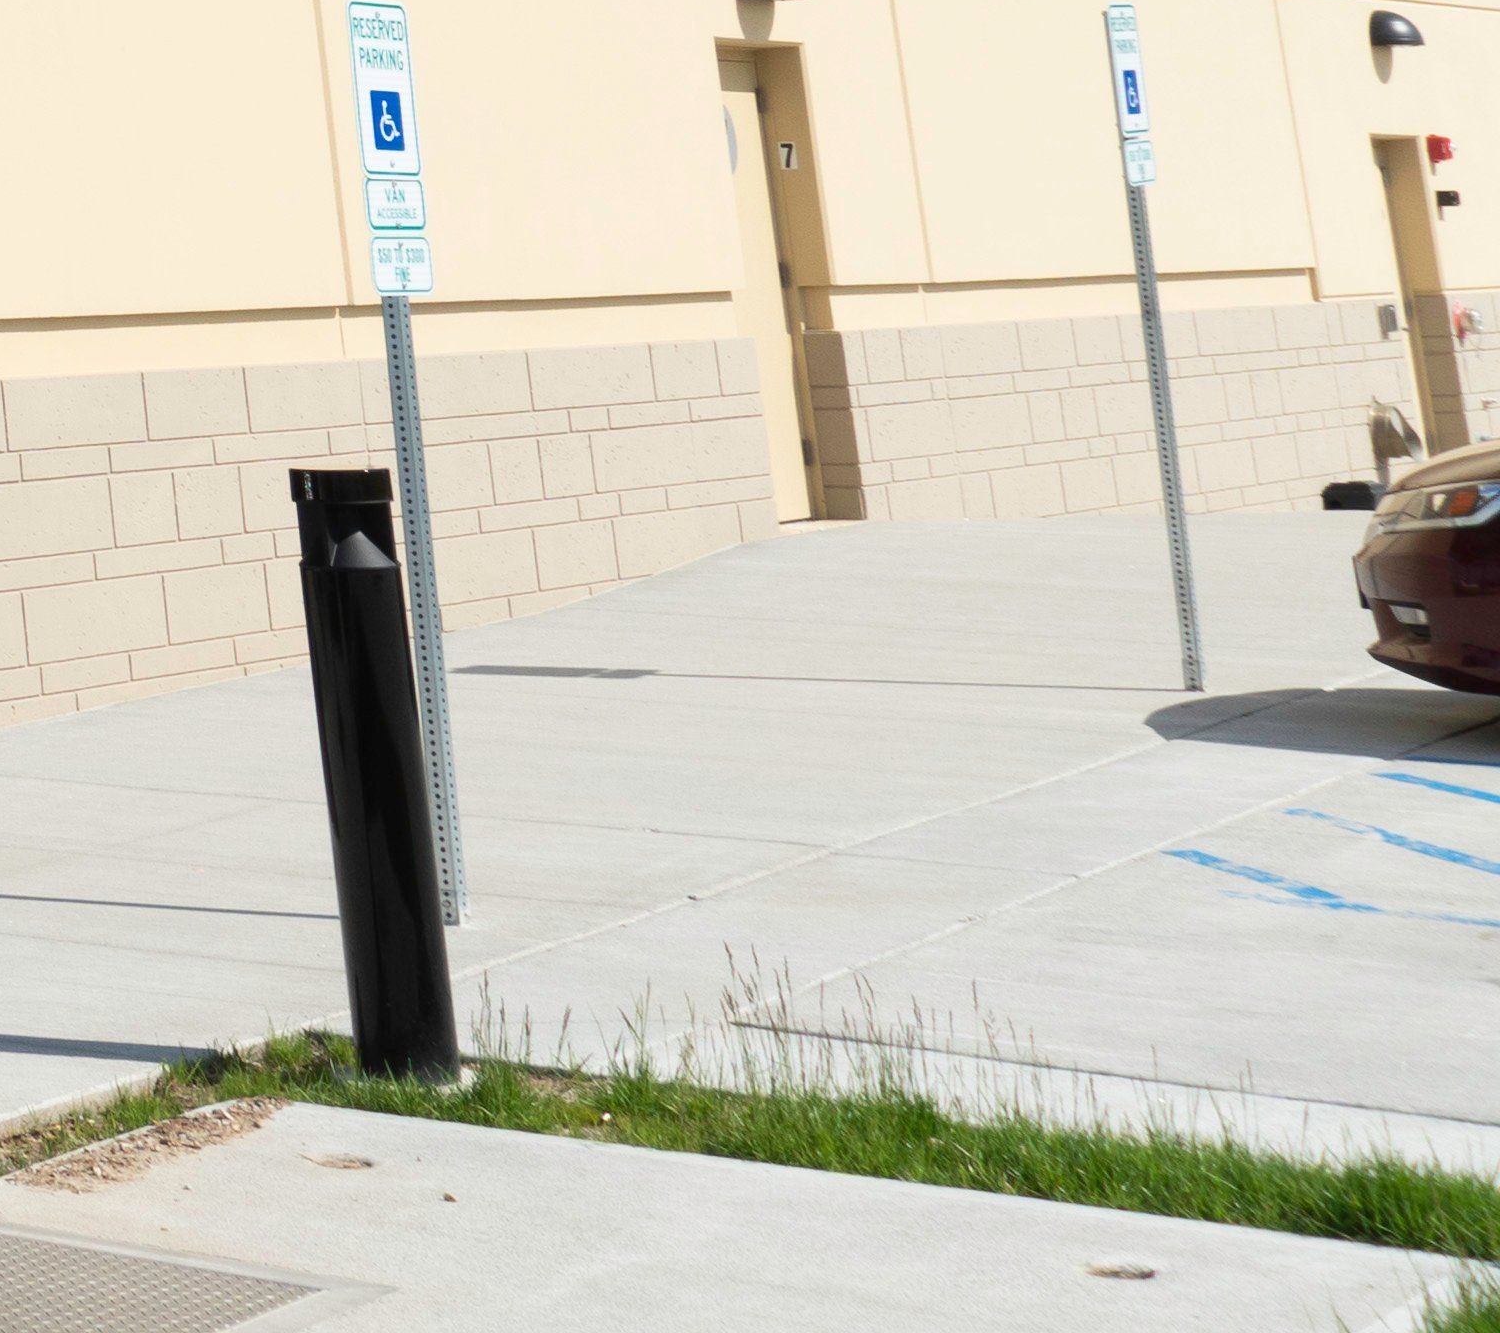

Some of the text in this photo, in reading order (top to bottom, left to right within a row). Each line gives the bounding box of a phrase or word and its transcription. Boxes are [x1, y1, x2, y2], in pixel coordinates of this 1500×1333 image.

[353, 17, 404, 41] RESERVED
[359, 47, 404, 71] PARKING
[385, 188, 406, 203] VAN
[377, 208, 417, 219] ACCESSIBLE
